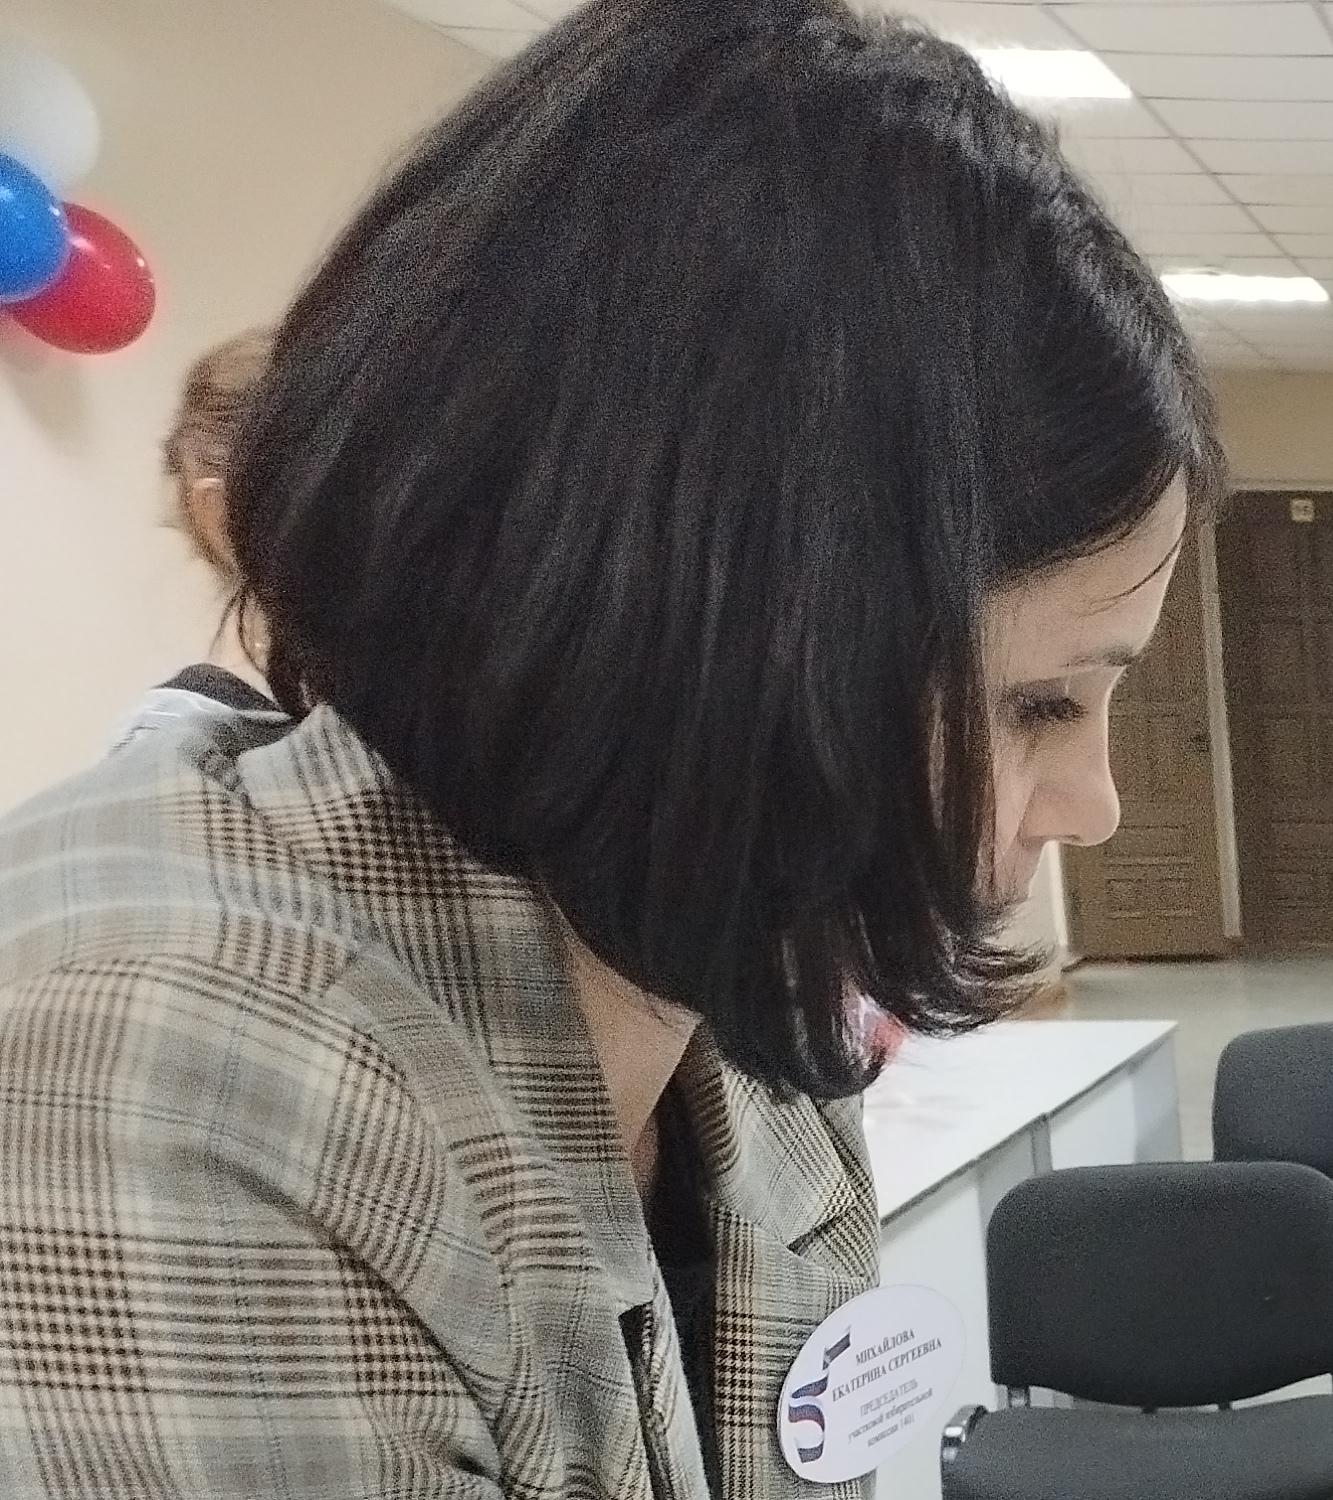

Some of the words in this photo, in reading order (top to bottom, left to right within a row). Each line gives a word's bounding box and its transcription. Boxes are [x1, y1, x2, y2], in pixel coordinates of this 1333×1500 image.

[856, 1329, 915, 1366] МИХАЙЛОВА
[832, 1365, 887, 1402] ЕКАТЕРИНА
[888, 1338, 942, 1372] СЕРГЕЕВНА
[860, 1378, 919, 1417] ПРЕДСЕДАТЕЛЬ
